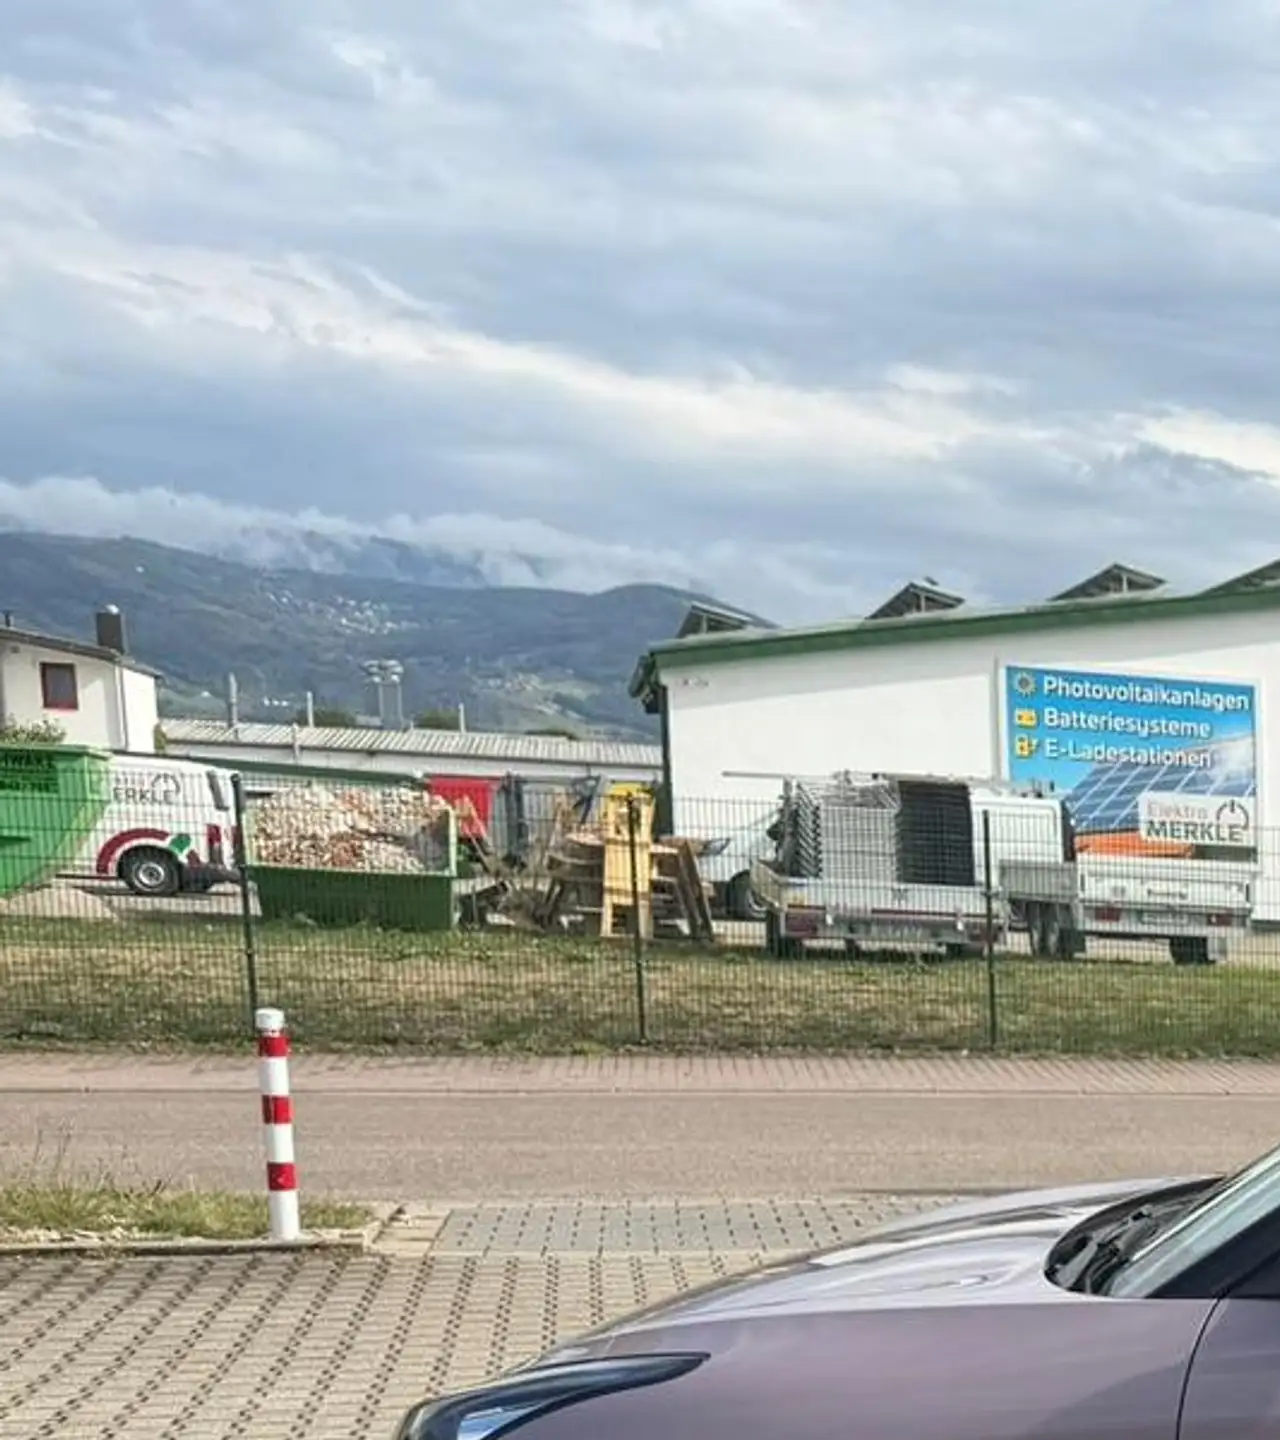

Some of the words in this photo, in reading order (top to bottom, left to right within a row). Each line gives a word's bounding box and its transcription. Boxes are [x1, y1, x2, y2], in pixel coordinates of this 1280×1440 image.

[1043, 675, 1249, 713] Photovoltaikanlagen
[1043, 707, 1211, 738] Batteriesysteme
[1044, 737, 1212, 768] E-Ladestationen
[1147, 819, 1242, 842] MERKLE
